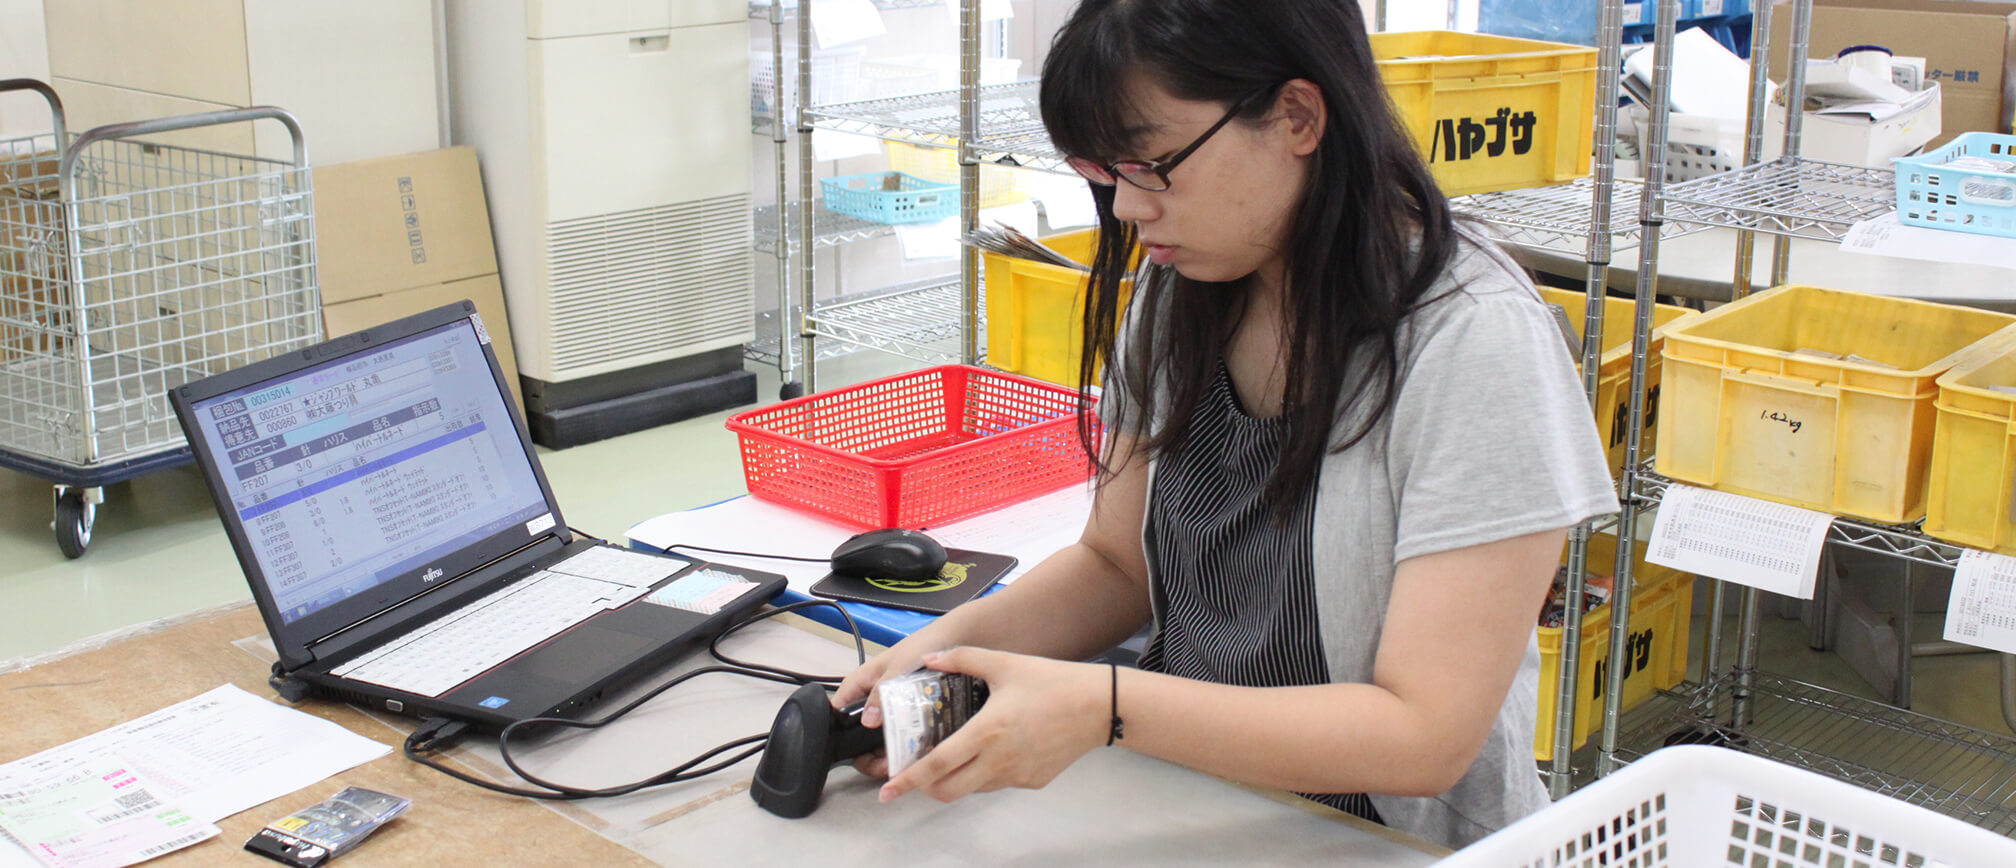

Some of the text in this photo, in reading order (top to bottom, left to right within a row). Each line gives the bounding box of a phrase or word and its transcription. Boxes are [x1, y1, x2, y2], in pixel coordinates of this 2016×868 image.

[1430, 107, 1537, 164] ハヤブサ
[250, 387, 291, 406] 00315014
[219, 417, 251, 434] 納品先
[259, 404, 294, 420] 0022767
[224, 428, 256, 447] 得意先
[236, 439, 278, 460] JANコード
[253, 458, 274, 473] 品番
[301, 445, 311, 456] 針
[322, 433, 348, 448] ハリス
[371, 417, 390, 430] 品名
[242, 476, 269, 491] FF207
[295, 460, 313, 472] 3/0
[438, 412, 444, 420] 5
[422, 567, 444, 583] FUJITSU
